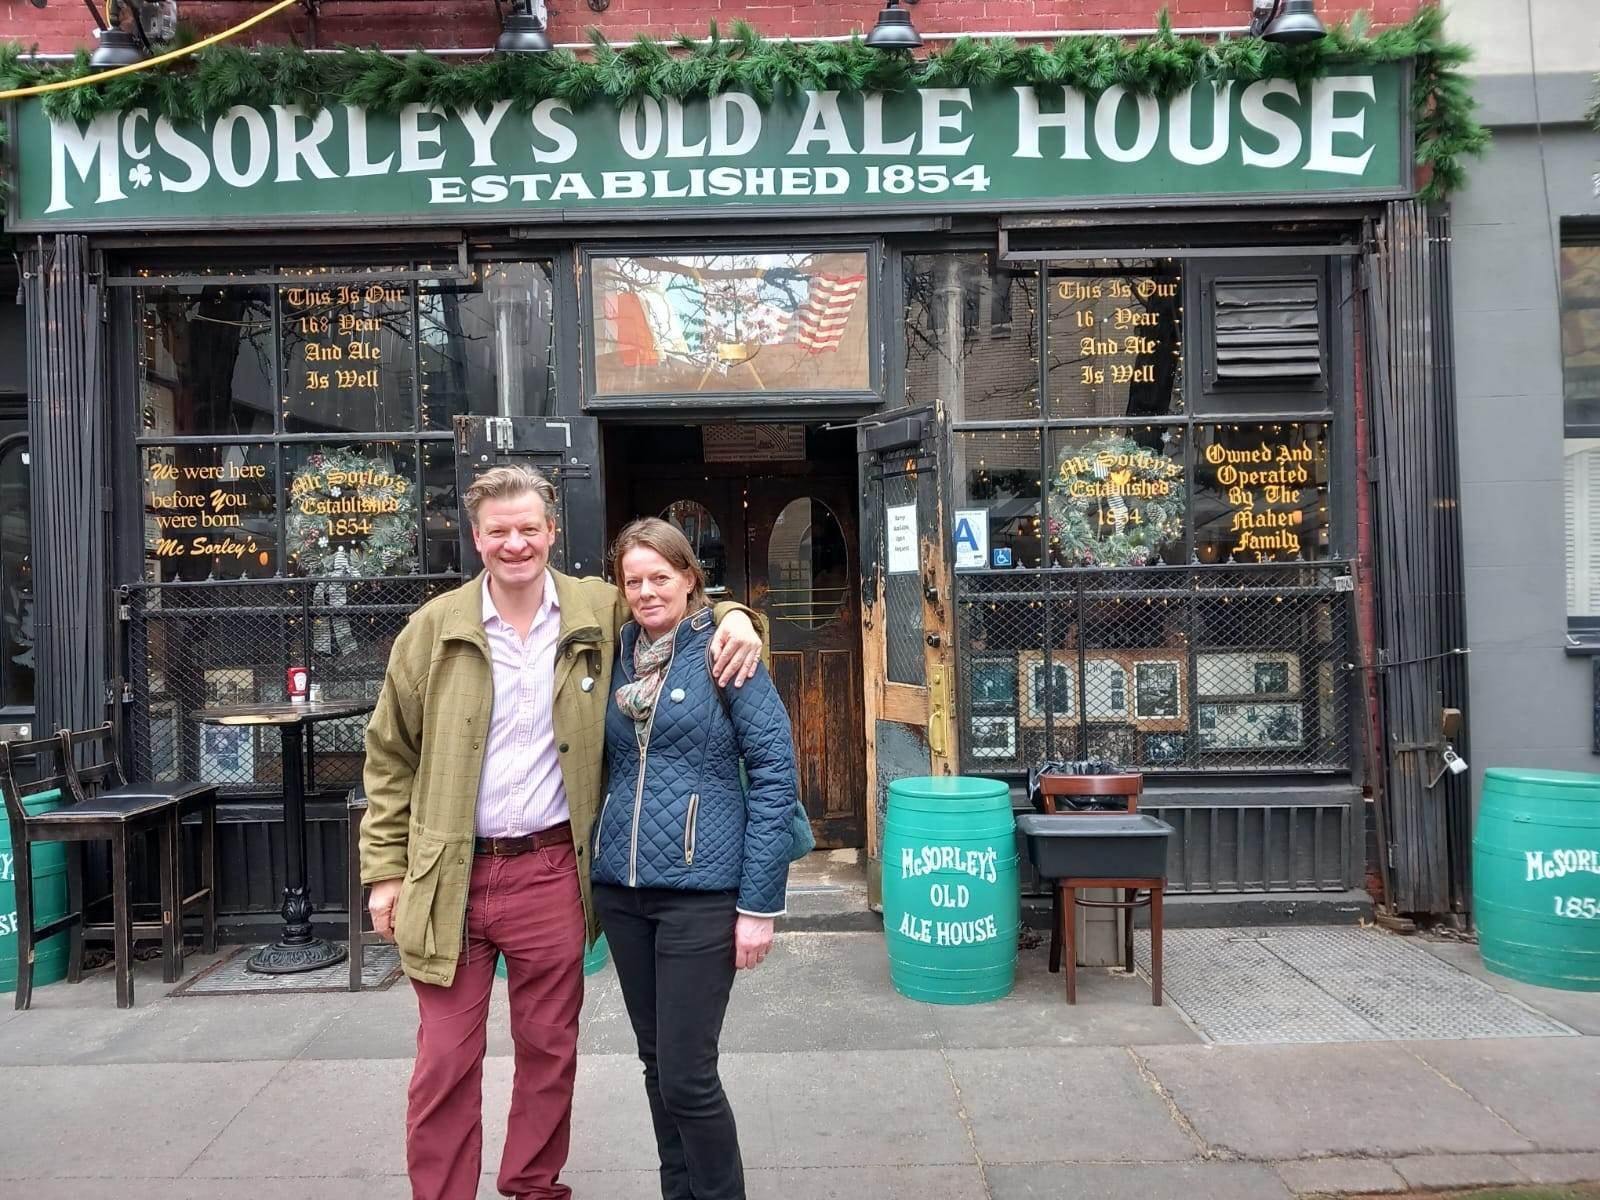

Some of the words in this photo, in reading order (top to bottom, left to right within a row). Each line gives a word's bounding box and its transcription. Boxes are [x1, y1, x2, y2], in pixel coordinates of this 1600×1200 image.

[619, 91, 761, 160] OLD
[787, 88, 974, 156] ALE
[1012, 75, 1376, 175] HOUSE
[428, 166, 850, 204] ESTABLISHED
[865, 164, 991, 194] 1854
[287, 288, 331, 307] This
[336, 285, 359, 305] Is
[365, 283, 405, 304] Our
[1058, 281, 1102, 300] This
[1107, 279, 1132, 298] Is
[1137, 279, 1177, 298] Our
[301, 316, 329, 333] 168
[338, 314, 383, 336] Year
[1114, 308, 1159, 330] Year
[304, 342, 342, 362] And
[348, 341, 381, 360] Ale
[1080, 337, 1118, 356] And
[1125, 336, 1156, 354] Ale
[306, 370, 329, 390] Is
[335, 369, 379, 388] Well
[1080, 365, 1104, 385] Is
[1110, 364, 1155, 384] Well
[1206, 441, 1272, 464] Owned
[1276, 440, 1312, 462] And
[150, 463, 179, 480] We
[183, 466, 225, 480] were
[229, 461, 266, 479] here
[1217, 463, 1307, 488] Operated
[1070, 478, 1169, 498] Established
[1228, 486, 1254, 511] By
[1264, 485, 1300, 504] The
[151, 490, 205, 509] before
[209, 489, 248, 513] You
[300, 496, 399, 516] Established
[155, 515, 197, 529] were
[327, 518, 374, 536] 1854
[953, 518, 979, 551] A
[1232, 529, 1301, 554] Family
[155, 538, 185, 557] Mc
[190, 535, 258, 560] Sorley's
[901, 845, 997, 884] McSORLEY'S
[930, 884, 969, 908] OLD
[1554, 896, 1600, 918] 185
[899, 912, 932, 944] ALE
[936, 914, 997, 946] HOUSE
